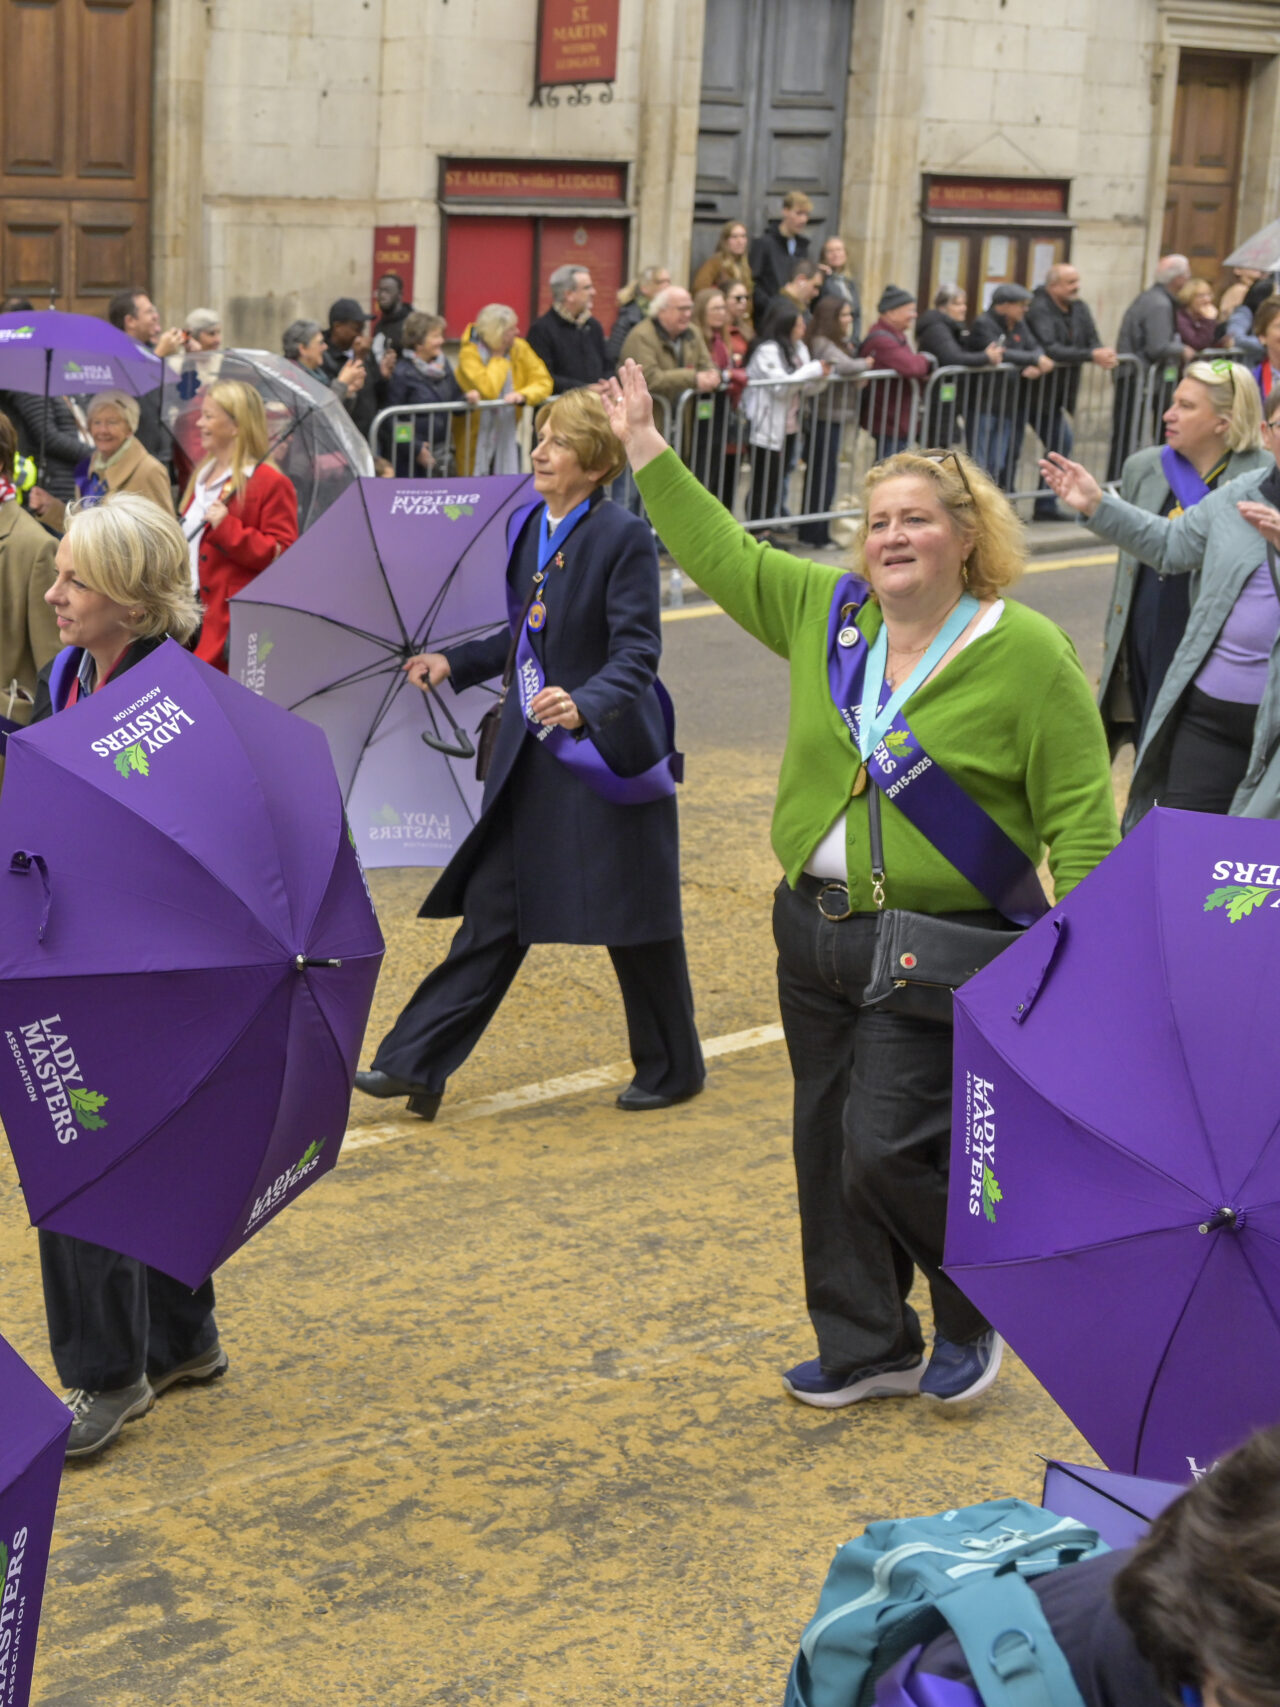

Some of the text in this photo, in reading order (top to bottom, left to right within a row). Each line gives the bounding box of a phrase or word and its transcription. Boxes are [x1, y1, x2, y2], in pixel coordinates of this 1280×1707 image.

[553, 23, 608, 41] MARTIN
[467, 171, 519, 187] MARTIN
[558, 174, 617, 190] LUDGATE
[91, 696, 180, 757] MASTERS
[113, 686, 161, 722] ASSOCIATION
[143, 709, 195, 754] LADY
[885, 756, 933, 799] 2015-2025
[4, 1030, 38, 1102] ASSOCIATION
[19, 1020, 78, 1145] MASTERS
[40, 1013, 84, 1083] LADY
[969, 1074, 984, 1216] MASTERS
[983, 1079, 995, 1165] LADY
[247, 1155, 320, 1226] MASTERS
[7, 1596, 26, 1705] ASSOCIATION
